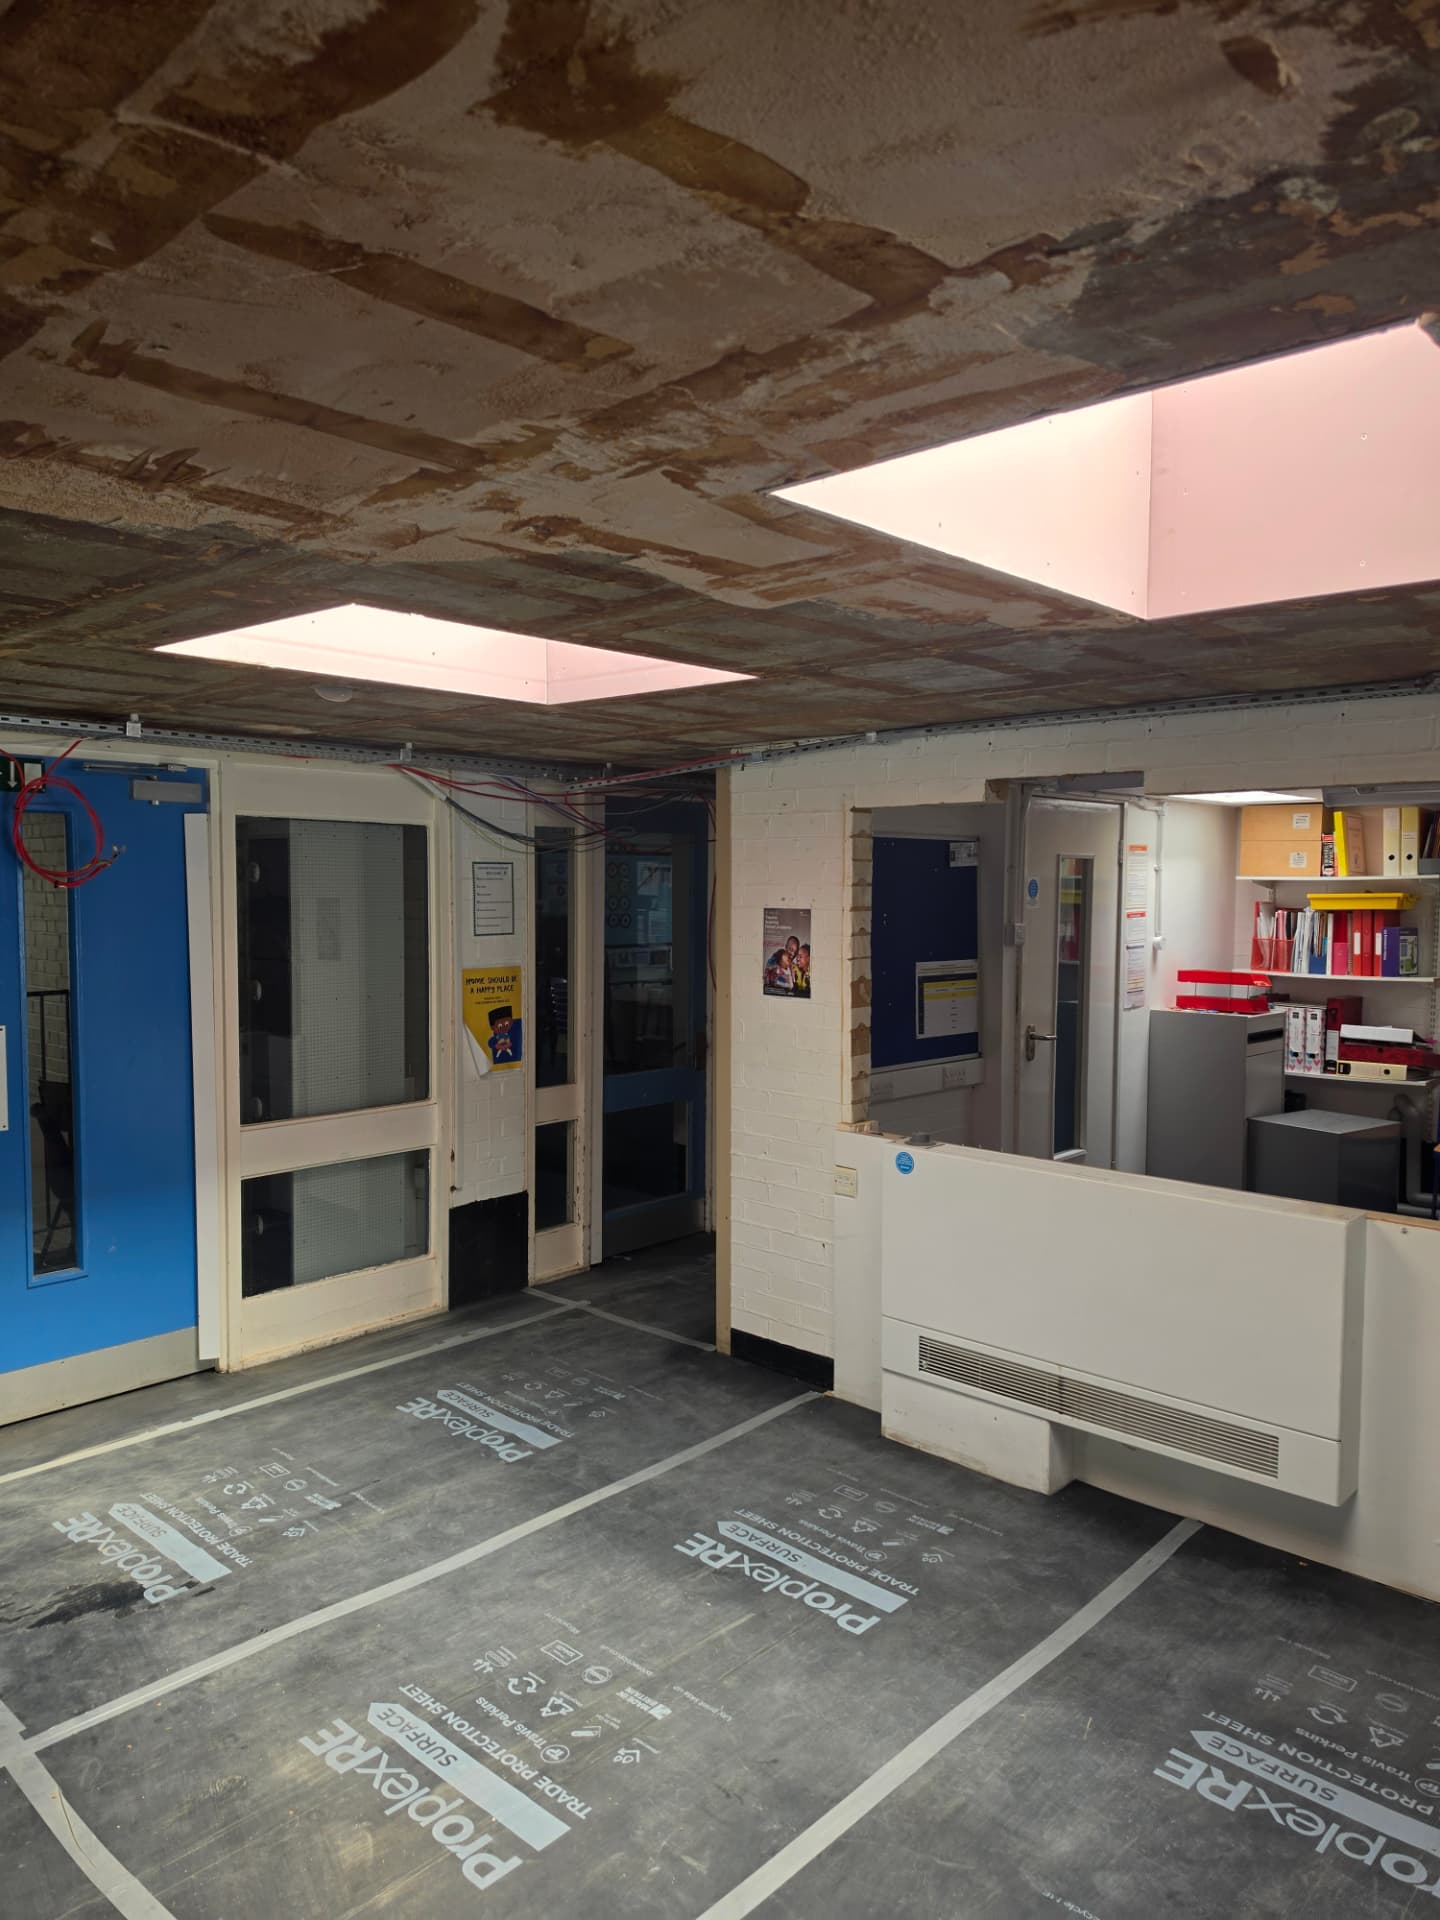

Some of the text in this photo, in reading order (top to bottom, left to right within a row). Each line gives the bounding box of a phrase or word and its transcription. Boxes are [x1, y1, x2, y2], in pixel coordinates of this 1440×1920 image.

[396, 1398, 533, 1462] ProplexRE
[442, 1392, 494, 1417] SURFACE
[456, 1383, 575, 1438] TRADE PROTECTION SHEET
[117, 1507, 167, 1537] SURFACE
[726, 1525, 802, 1562] SURFACE
[52, 1511, 188, 1603] ProplexRE
[216, 1542, 253, 1567] TRADE
[734, 1509, 918, 1595] TRADE PROTECTION SHEET
[674, 1533, 880, 1635] ProplexRE
[377, 1708, 458, 1766] SURFACE
[476, 1697, 516, 1727] Perkins
[514, 1724, 546, 1749] Travis
[399, 1684, 592, 1819] TRADE PROTECTION SHEET
[1202, 1711, 1434, 1816] PROTECTION SHEET
[1207, 1735, 1338, 1801] SURFACE
[1295, 1727, 1355, 1759] Perkins
[1360, 1755, 1411, 1783] Travis
[301, 1719, 522, 1890] ProplexRE
[1153, 1748, 1440, 1899] roplexRE
